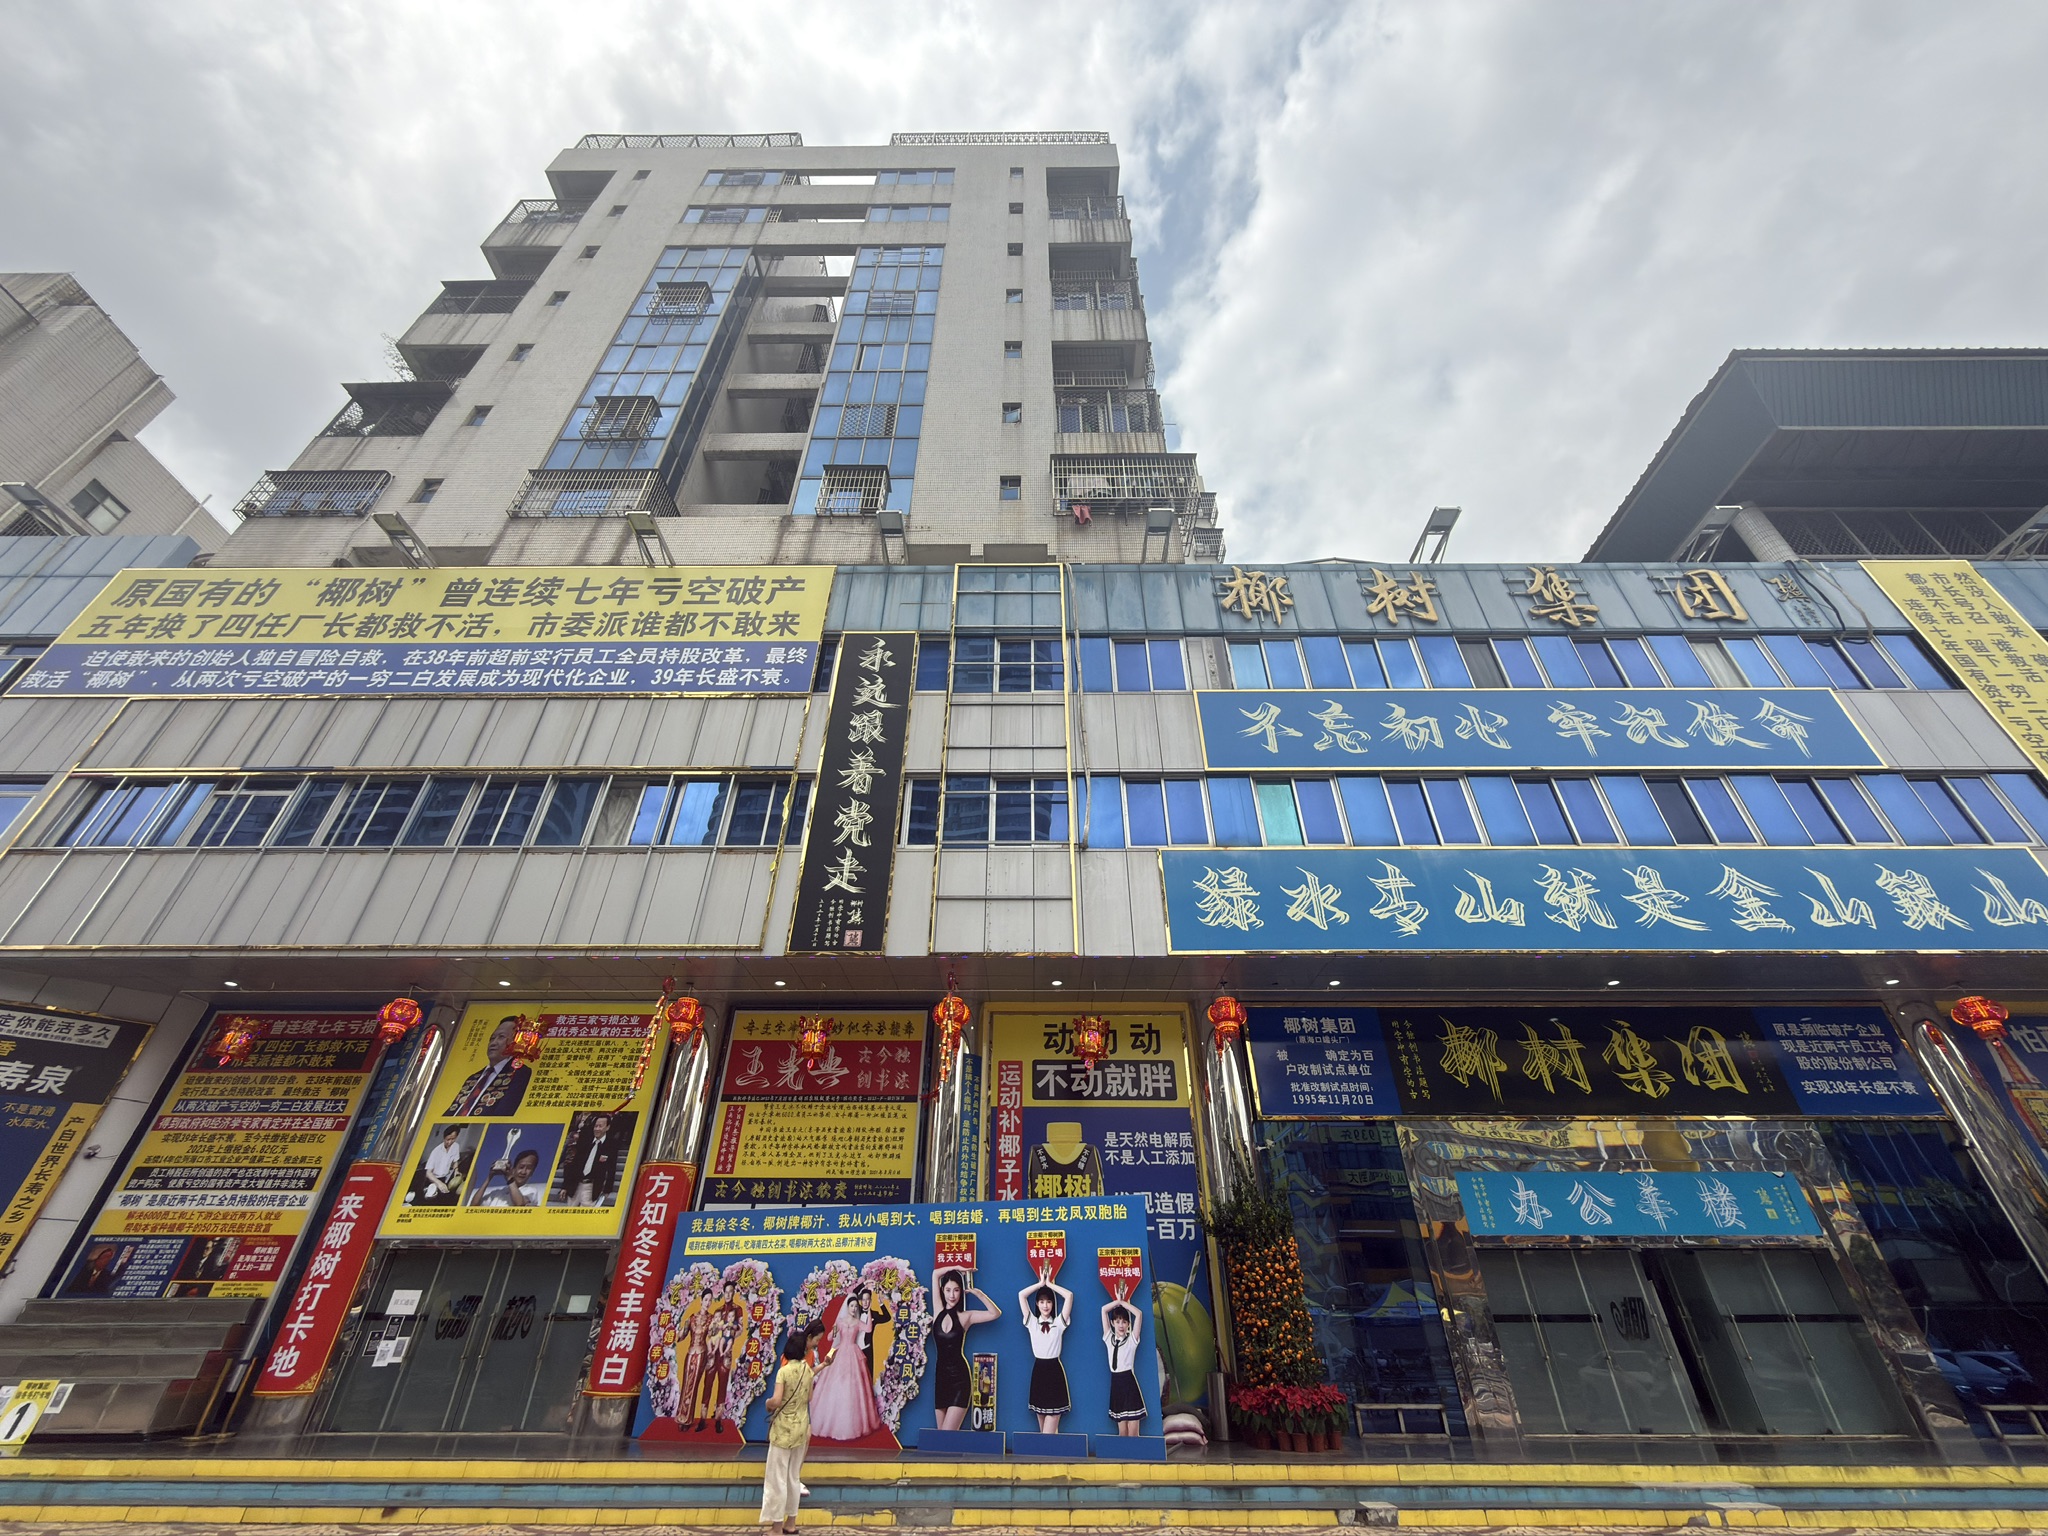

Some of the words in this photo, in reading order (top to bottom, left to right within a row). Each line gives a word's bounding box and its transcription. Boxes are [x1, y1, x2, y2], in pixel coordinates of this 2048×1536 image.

[1220, 565, 1749, 628] 椰树集团
[77, 611, 801, 640] 五年换了四任厂长都救不活，市委派谁都不敢来
[1237, 699, 1512, 754] 不忘初心
[1547, 697, 1816, 758] 牢记使命
[822, 636, 901, 894] 永远跟着党走
[1193, 858, 2048, 938] 绿水青山就是金山银山
[555, 1014, 640, 1025] 救活三家亏损企业
[1284, 1017, 1357, 1034] 椰树集团
[1772, 1023, 1885, 1037] 原是濒临破产企业
[1781, 1039, 1893, 1053] 现是近两千员工持
[1276, 1050, 1290, 1062] 被
[1325, 1049, 1374, 1062] 确定为百
[1286, 1064, 1372, 1076] 户改制试点单位
[1796, 1056, 1898, 1071] 股的股份制公司
[1036, 1062, 1174, 1098] 不动就胖
[1800, 1080, 1919, 1095] 实现38年长盛不衰
[175, 1100, 345, 1113] 从两次破产亏空的一穷二白发展壮大
[1293, 1094, 1374, 1105] 1995年11月20日
[2, 1103, 56, 1117] 不是普通
[158, 1116, 347, 1130] 得到政府和经济学专家肯定并在全国推广
[998, 1064, 1022, 1201] 运动补椰子水
[1104, 1131, 1194, 1148] 是天然电解质
[1105, 1149, 1196, 1166] 不是人工添加
[5, 1116, 86, 1223] 产自世界长寿之乡
[1034, 1174, 1092, 1198] 椰树
[942, 1243, 968, 1252] 上大学
[1033, 1240, 1058, 1249] 上中学
[937, 1253, 973, 1263] 我天天喝
[1030, 1249, 1064, 1258] 我自己喝
[1108, 1257, 1134, 1267] 上小学
[267, 1176, 374, 1377] 一来椰树打卡地
[599, 1172, 674, 1385] 方知冬冬丰满白
[1099, 1268, 1141, 1278] 妈妈叫我喝
[4, 1402, 32, 1440] 1
